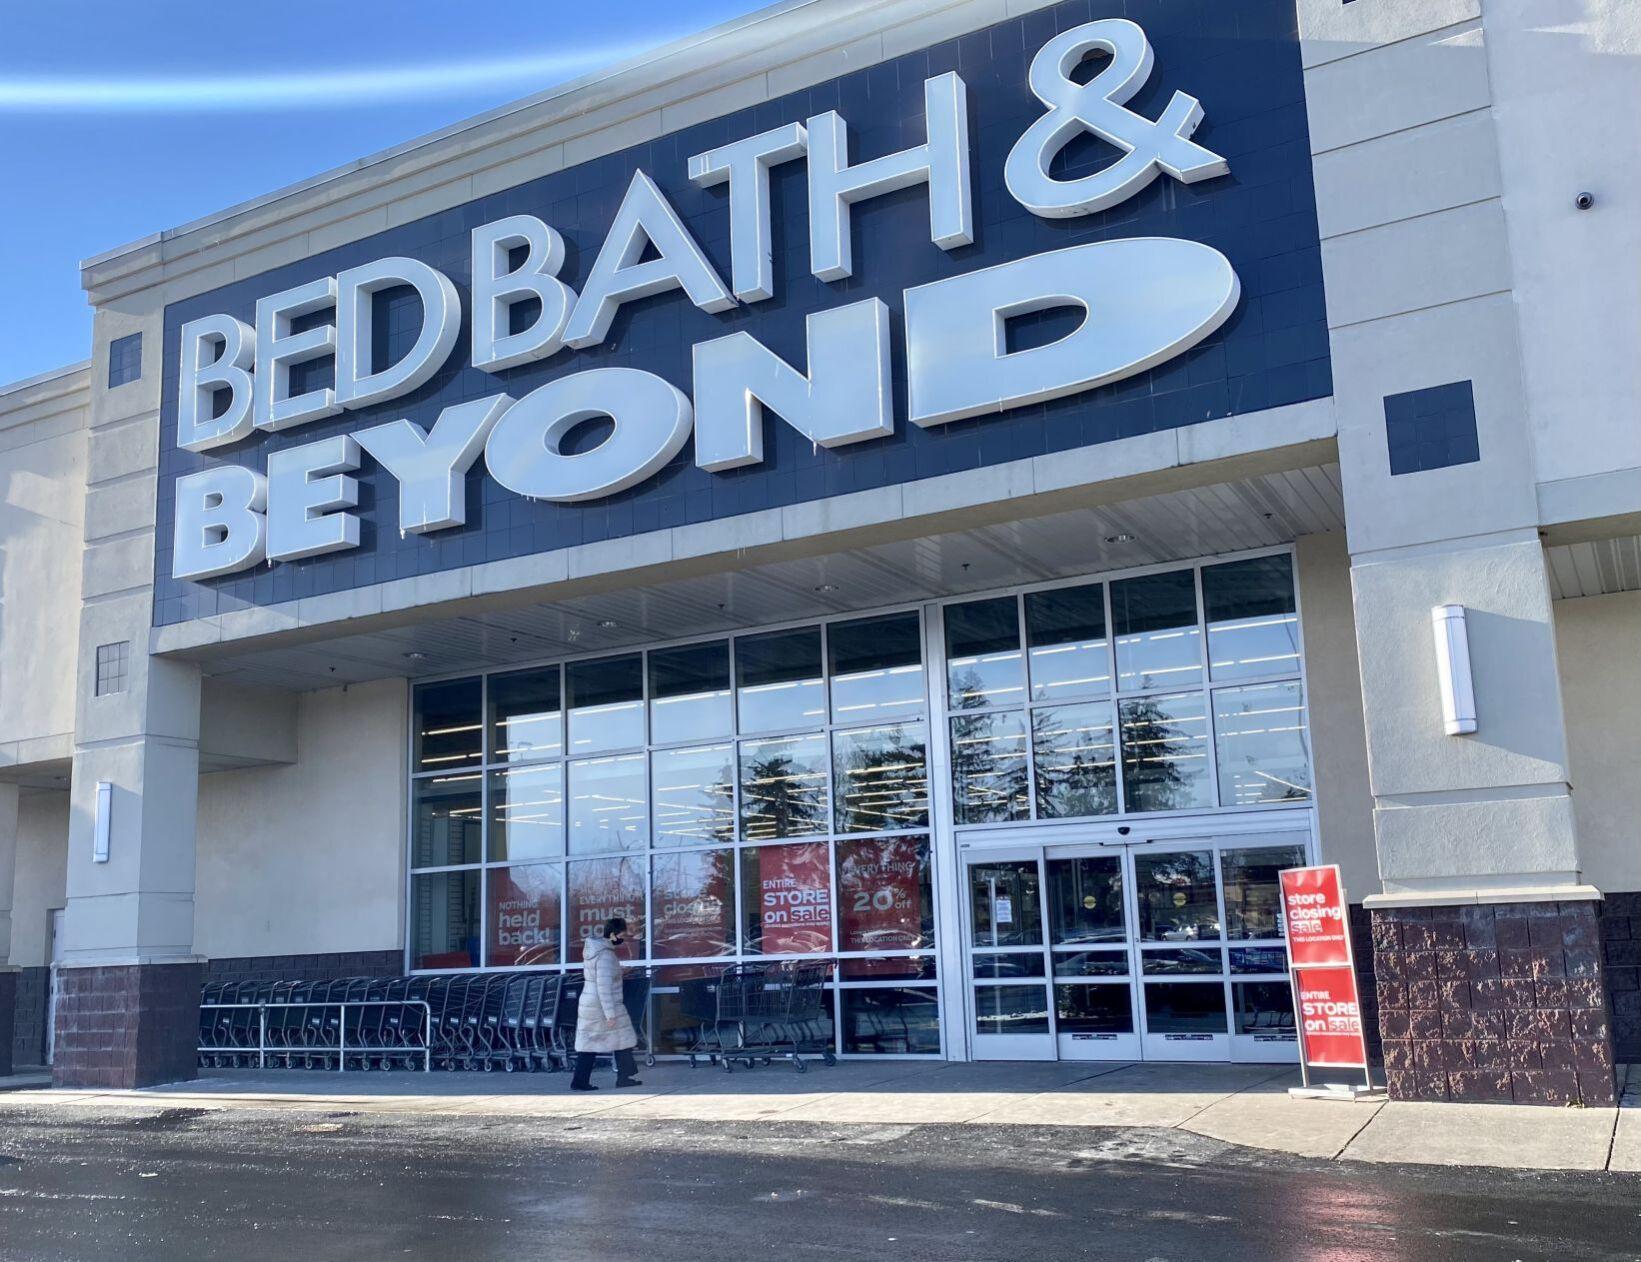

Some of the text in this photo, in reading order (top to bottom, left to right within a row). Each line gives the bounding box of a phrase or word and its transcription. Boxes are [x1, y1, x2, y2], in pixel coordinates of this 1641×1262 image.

[177, 18, 1231, 453] BED BATH &
[172, 236, 1241, 580] BEYOND
[763, 878, 797, 889] ENTIRE
[499, 900, 538, 911] NOTHING
[764, 889, 829, 906] STORE
[853, 889, 893, 912] 20
[894, 899, 912, 909] off
[1288, 893, 1326, 906] store
[579, 904, 635, 922] must
[664, 900, 721, 915] clos
[764, 905, 829, 923] on sale
[1290, 904, 1342, 921] closing
[499, 910, 540, 928] held
[1291, 920, 1322, 934] sale
[499, 928, 550, 946] back!
[1301, 991, 1331, 1001] ENTIRE
[1303, 1002, 1358, 1016] STORE
[1305, 1016, 1361, 1032] on sale
